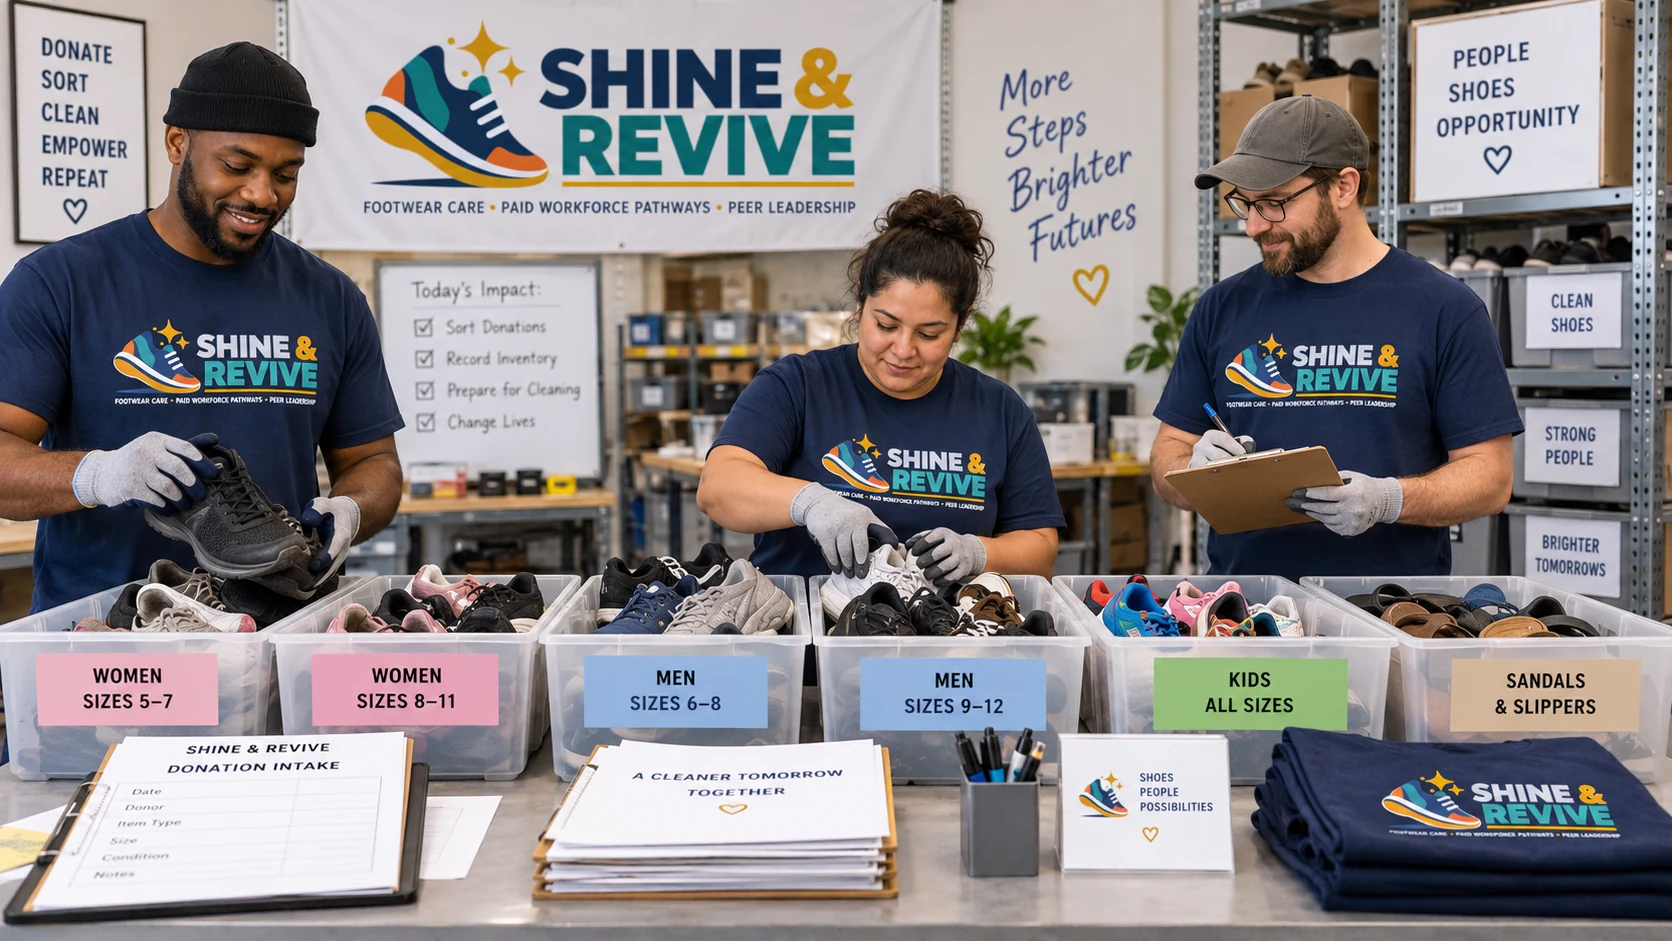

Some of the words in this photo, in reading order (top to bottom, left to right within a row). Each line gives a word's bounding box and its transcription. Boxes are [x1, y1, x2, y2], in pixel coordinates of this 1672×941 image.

[42, 36, 112, 64] DONATE
[1454, 42, 1530, 70] PEOPLE
[42, 70, 88, 92] SORT
[538, 48, 782, 110] SHINE
[794, 48, 854, 110] &
[1000, 68, 1072, 112] More
[1448, 78, 1514, 102] SHOES
[42, 102, 98, 126] CLEAN
[1436, 104, 1580, 138] OPPORTUNITY
[1005, 110, 1087, 159] Steps
[42, 134, 128, 158] EMPOWER
[562, 114, 856, 176] REVIVE
[42, 166, 108, 188] REPEAT
[1008, 149, 1132, 212] Brighter
[364, 200, 442, 214] FOOTWEAR
[448, 200, 484, 214] CARE
[502, 200, 534, 214] PAID
[538, 200, 628, 214] WORKFORCE
[634, 200, 710, 214] PATHWAYS
[728, 200, 762, 214] PEER
[768, 200, 856, 214] LEADERSHIP
[1028, 203, 1137, 262] Futures
[410, 280, 472, 304] Today's
[481, 281, 541, 303] Impact:
[1552, 292, 1592, 308] CLEAN
[446, 318, 476, 336] Sort
[482, 318, 546, 334] Donations
[1552, 316, 1594, 332] SHOES
[196, 334, 290, 358] SHINE
[296, 336, 318, 362] &
[1292, 344, 1374, 368] SHINE
[1378, 344, 1400, 368] &
[446, 350, 490, 366] Record
[498, 352, 558, 370] Inventory
[204, 360, 318, 389] REVIVE
[1296, 368, 1398, 392] REVIVE
[448, 382, 496, 402] Prepare
[502, 382, 522, 396] for
[528, 382, 580, 402] Cleaning
[448, 414, 496, 434] Change
[502, 414, 536, 428] Lives
[1546, 426, 1596, 442] STRONG
[887, 448, 963, 472] SHINE
[967, 453, 986, 475] &
[1546, 450, 1594, 466] PEOPLE
[892, 469, 986, 497] REVIVE
[1542, 534, 1600, 554] BRIGHTER
[1534, 558, 1606, 578] TOMORROWS
[92, 668, 162, 684] WOMEN
[372, 668, 442, 684] WOMEN
[656, 670, 694, 686] MEN
[936, 672, 974, 688] MEN
[1230, 672, 1270, 688] KIDS
[1506, 672, 1586, 688] SANDALS
[84, 694, 134, 710] SIZES
[356, 694, 408, 708] SIZES
[630, 696, 680, 710] SIZES
[904, 698, 954, 714] SIZES
[1204, 698, 1238, 712] ALL
[1244, 698, 1294, 714] SIZES
[1494, 698, 1506, 714] &
[1514, 698, 1596, 714] SLIPPERS
[186, 744, 242, 755] SHINE
[246, 744, 259, 754] &
[265, 743, 330, 753] REVIVE
[168, 762, 266, 774] DONATION
[273, 761, 340, 771] INTAKE
[650, 772, 731, 781] CLEANER
[738, 770, 842, 780] TOMORROW
[1139, 772, 1174, 783] SHOES
[687, 787, 785, 797] TOGETHER
[1139, 787, 1179, 797] PEOPLE
[1471, 783, 1575, 803] SHINE
[1578, 784, 1607, 804] &
[1140, 801, 1214, 812] POSSIBILITIES
[1482, 803, 1615, 826] REVIVE
[152, 819, 182, 828] Type
[101, 853, 170, 862] Condition
